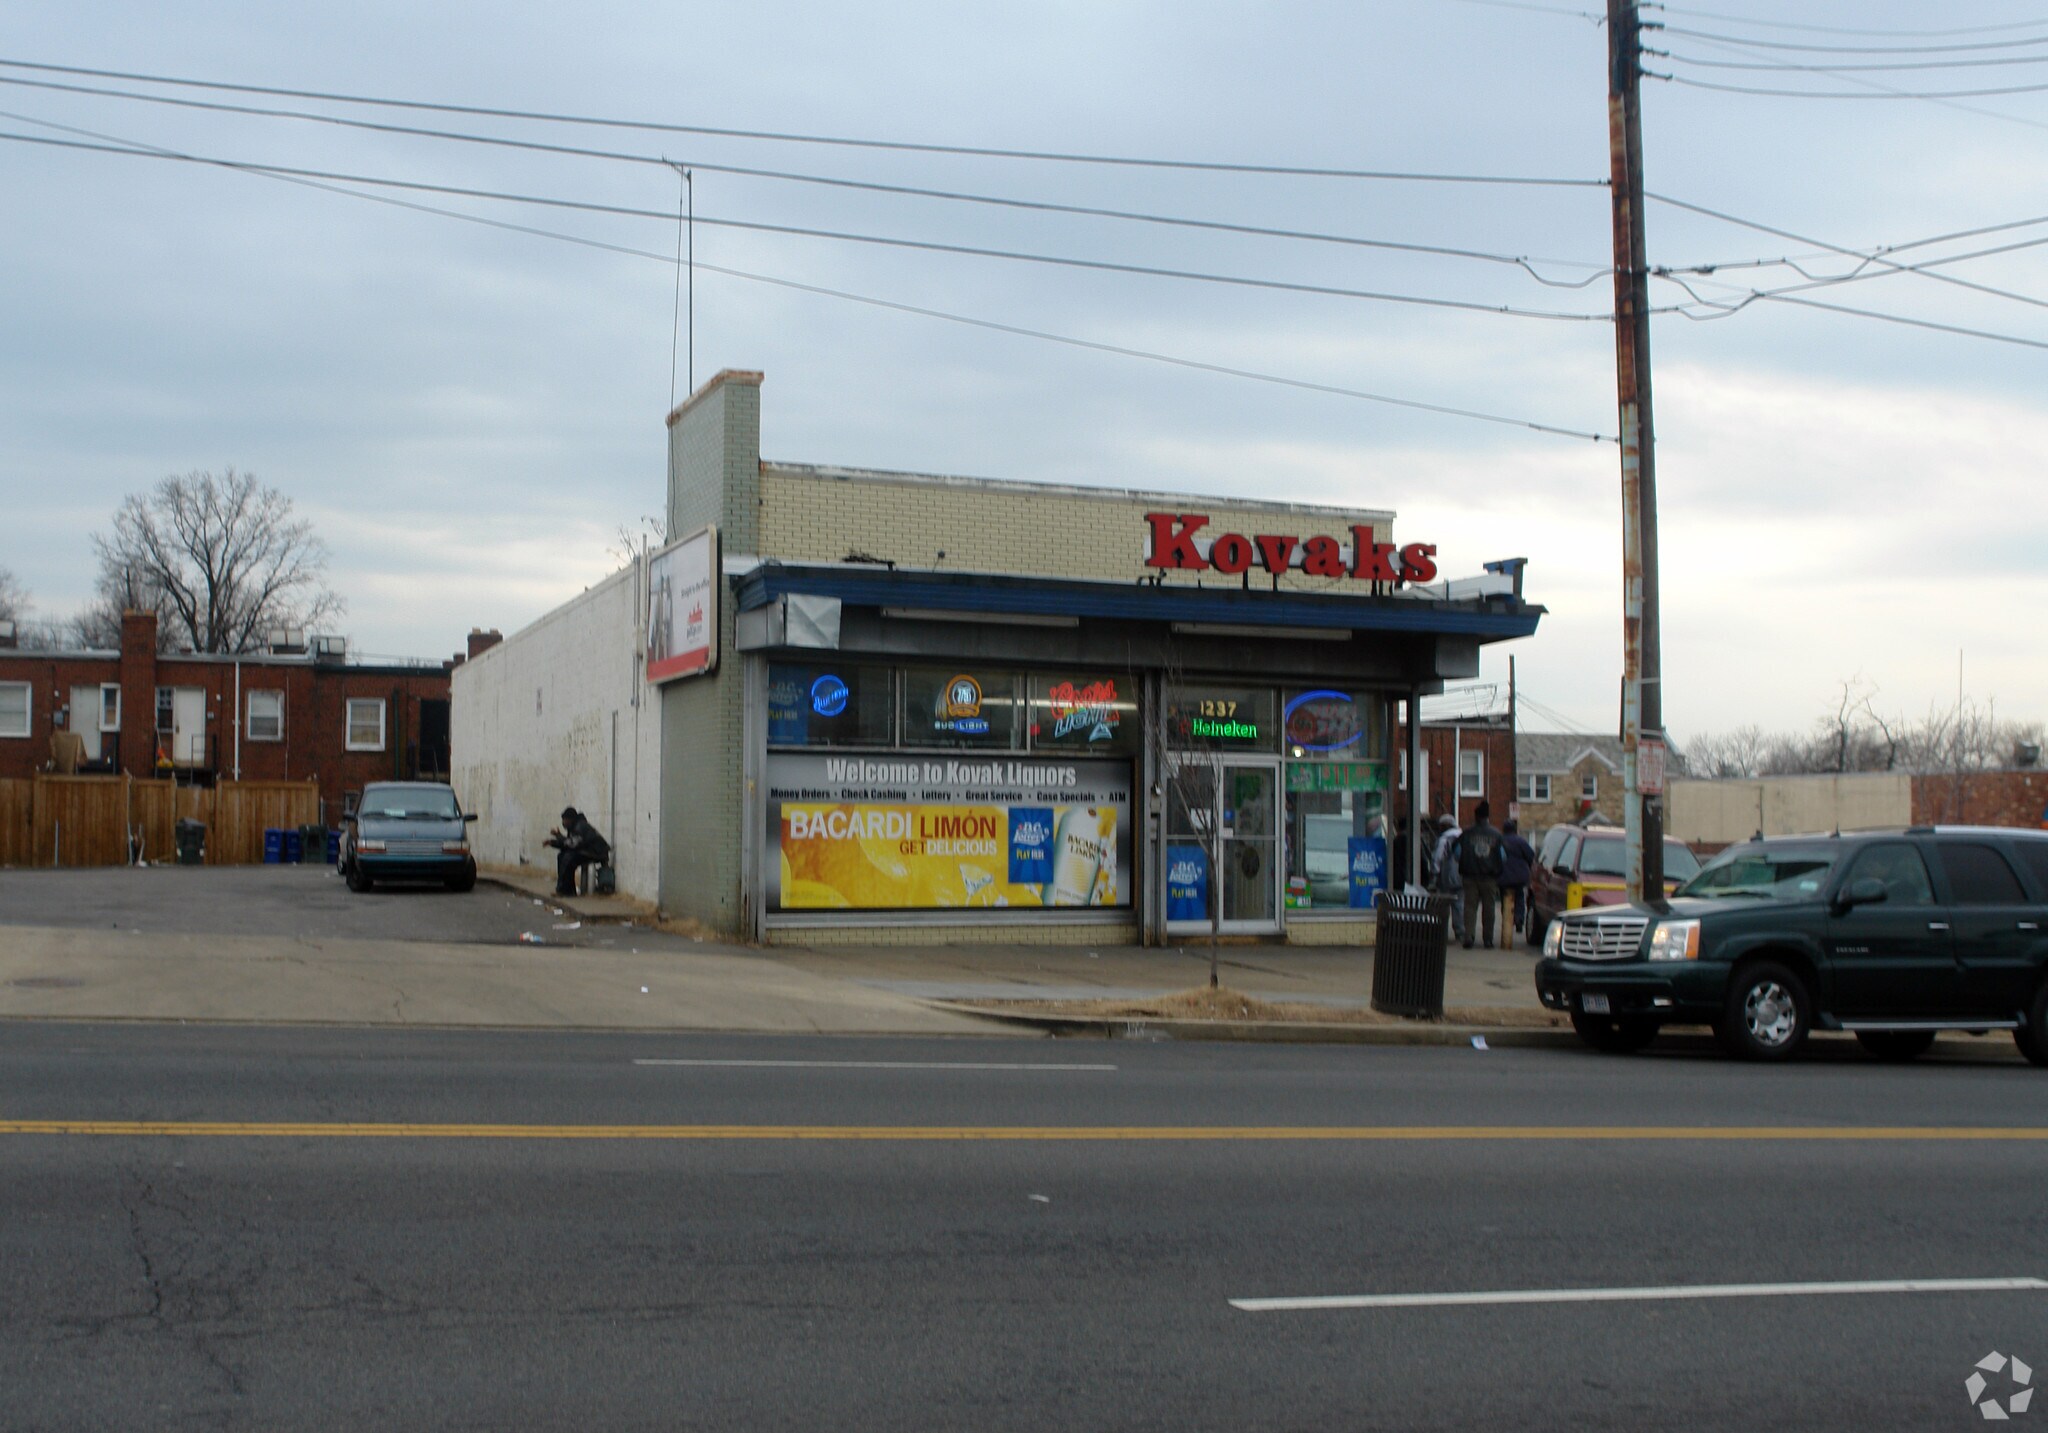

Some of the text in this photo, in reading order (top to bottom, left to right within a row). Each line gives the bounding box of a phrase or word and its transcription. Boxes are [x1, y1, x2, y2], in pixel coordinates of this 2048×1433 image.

[1144, 512, 1438, 582] Kovaks
[934, 720, 989, 730] BUD LIGHT
[1193, 718, 1257, 738] Heineken
[826, 758, 1077, 788] Welcome to Kovak Liquors
[770, 788, 1126, 803] Money Orders Check Cashing Lottery Great Service Case Specials ATM
[790, 809, 997, 840] BACARDI LIMÓN
